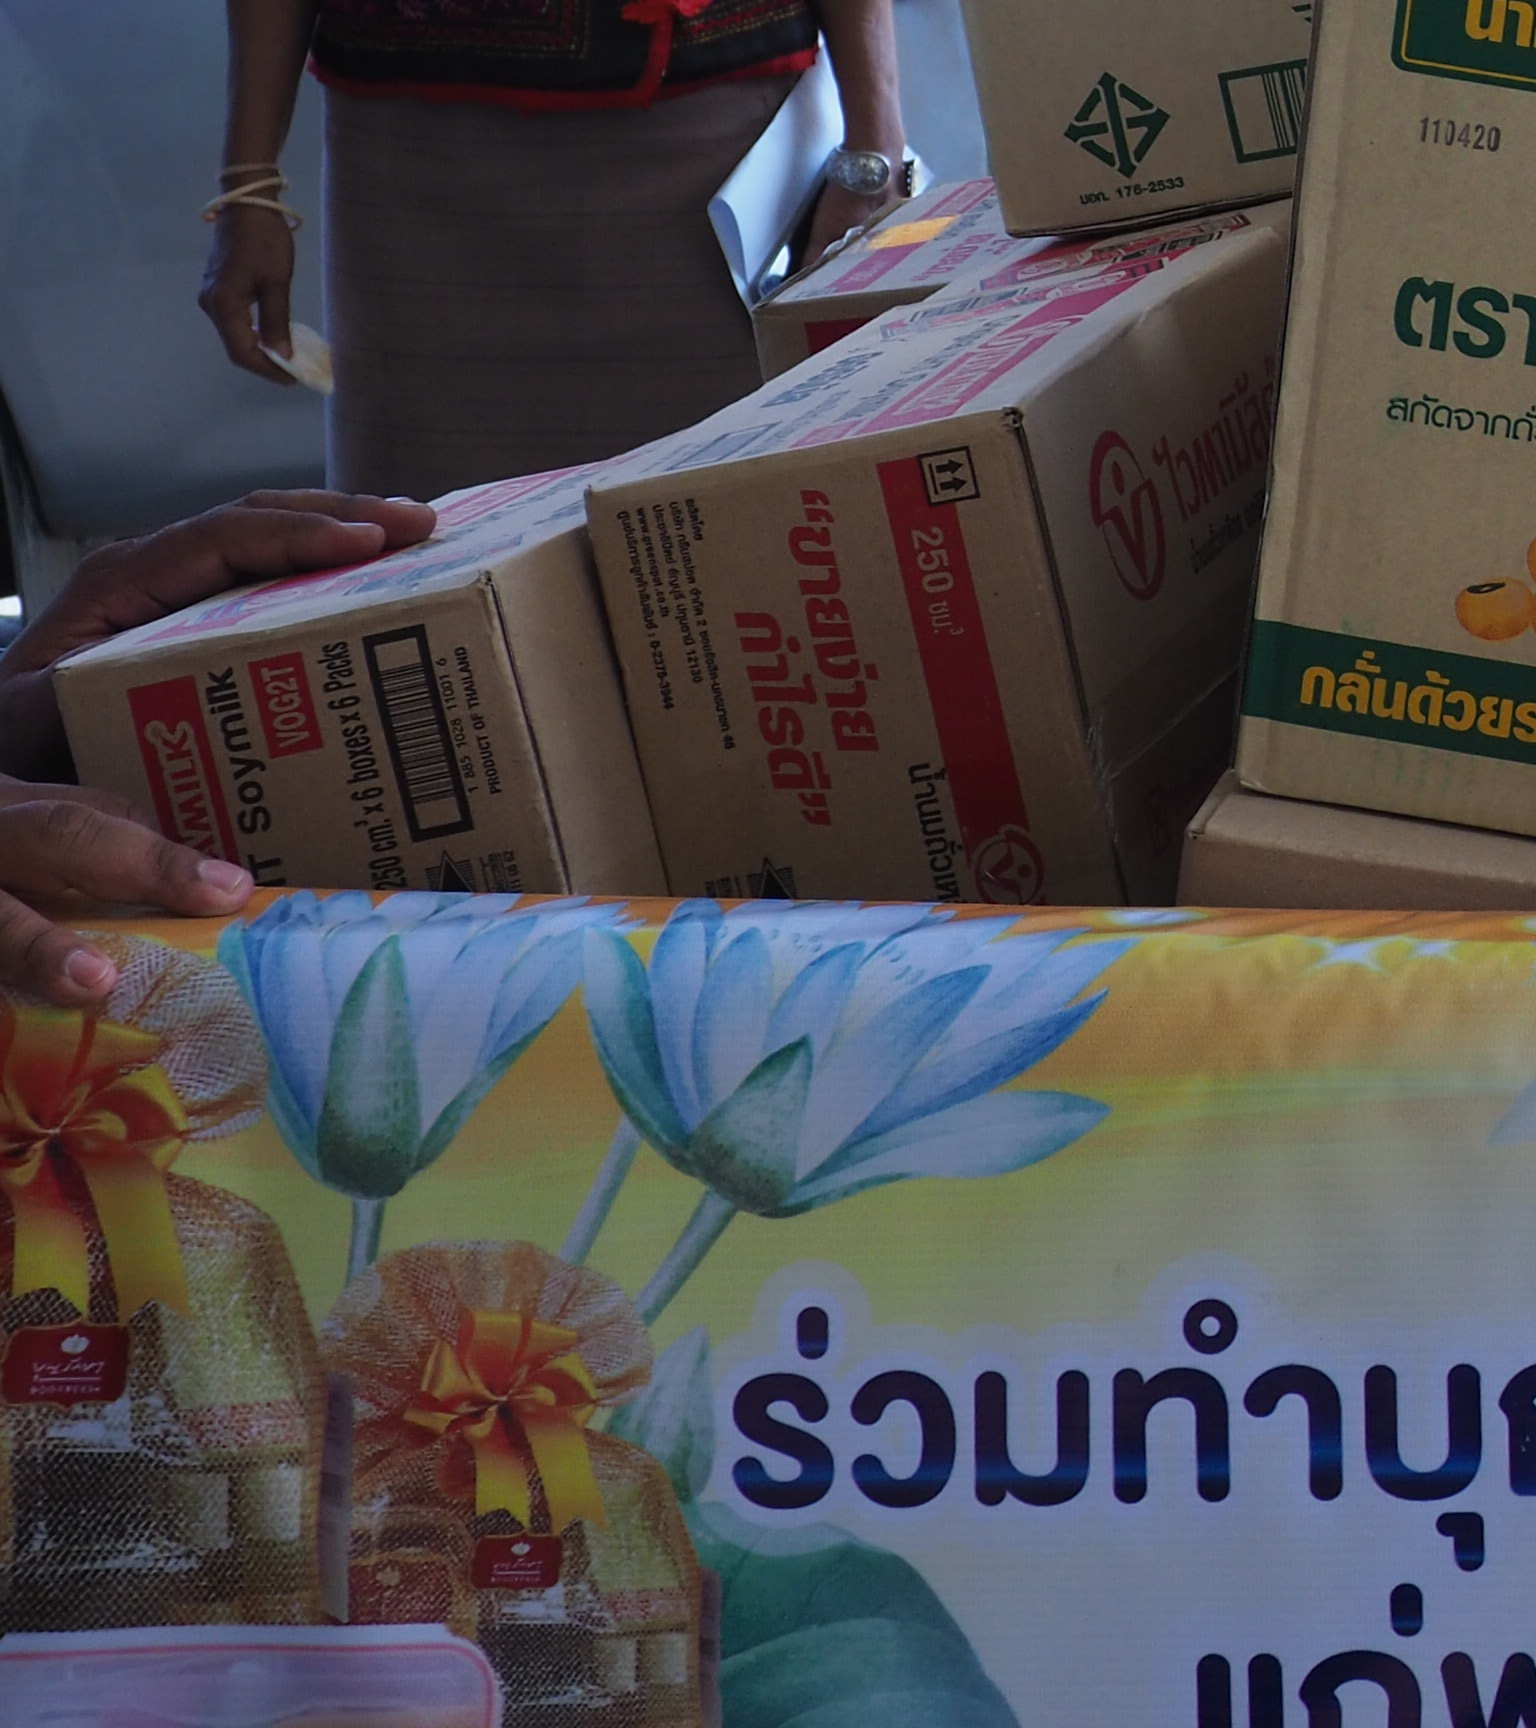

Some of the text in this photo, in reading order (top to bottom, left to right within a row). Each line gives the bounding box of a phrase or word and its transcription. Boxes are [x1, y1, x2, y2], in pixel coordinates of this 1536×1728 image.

[1418, 116, 1502, 154] 110420
[1115, 177, 1184, 201] 176-2533
[910, 524, 955, 596] 250
[787, 488, 879, 756] “ขายง่าย
[315, 640, 356, 693] Packs
[439, 673, 458, 711] 11001
[261, 661, 312, 748] VOG2T
[330, 694, 361, 710] 6
[453, 646, 503, 794] PRODUCT OF THAILAND
[734, 613, 831, 826] กำไรดี”
[203, 664, 276, 837] Soymilk
[337, 723, 379, 783] boxes
[449, 717, 466, 749] 1028
[355, 786, 384, 801] 6
[458, 755, 475, 779] 885
